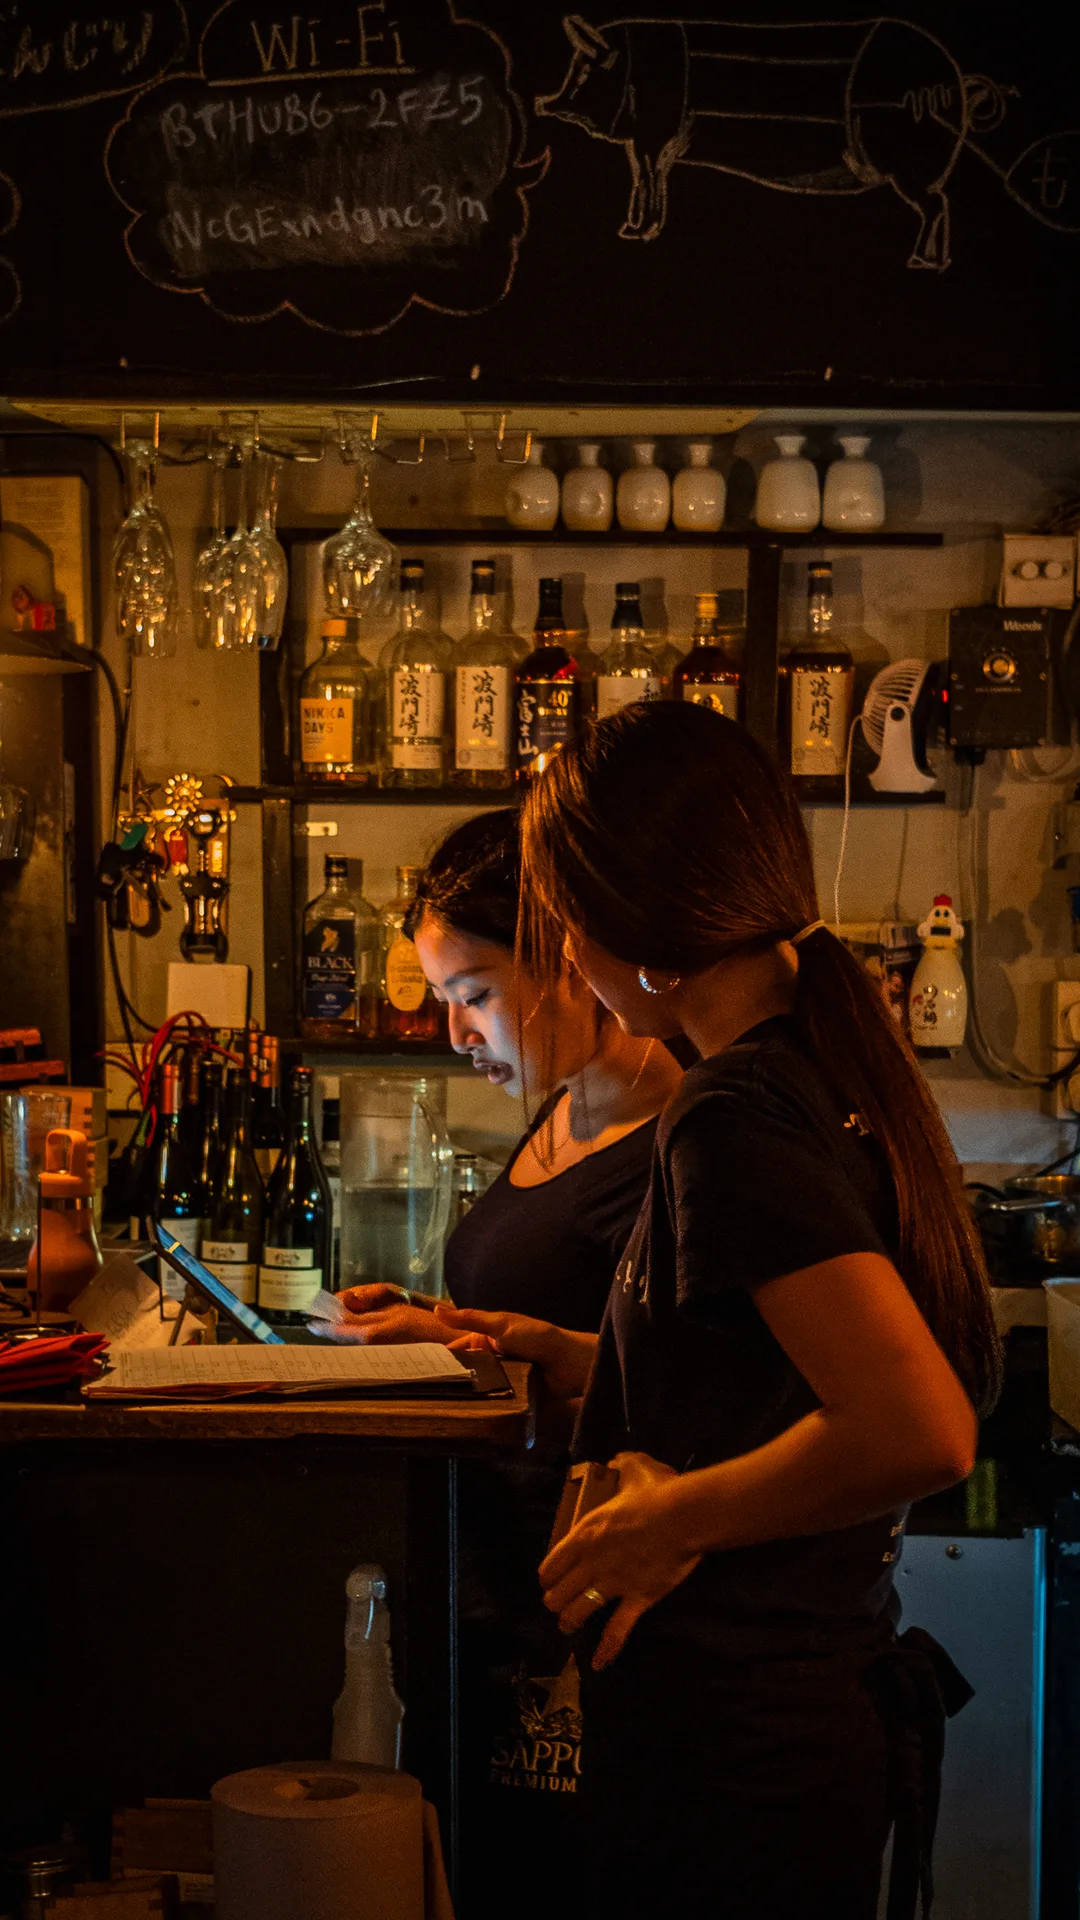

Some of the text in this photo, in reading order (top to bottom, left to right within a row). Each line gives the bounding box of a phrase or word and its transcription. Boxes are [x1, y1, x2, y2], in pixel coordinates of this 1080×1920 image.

[250, 2, 408, 73] Wi-Fi
[304, 721, 335, 734] DAYS
[307, 955, 354, 969] BLACK
[488, 1767, 577, 1793] PREMIUM
